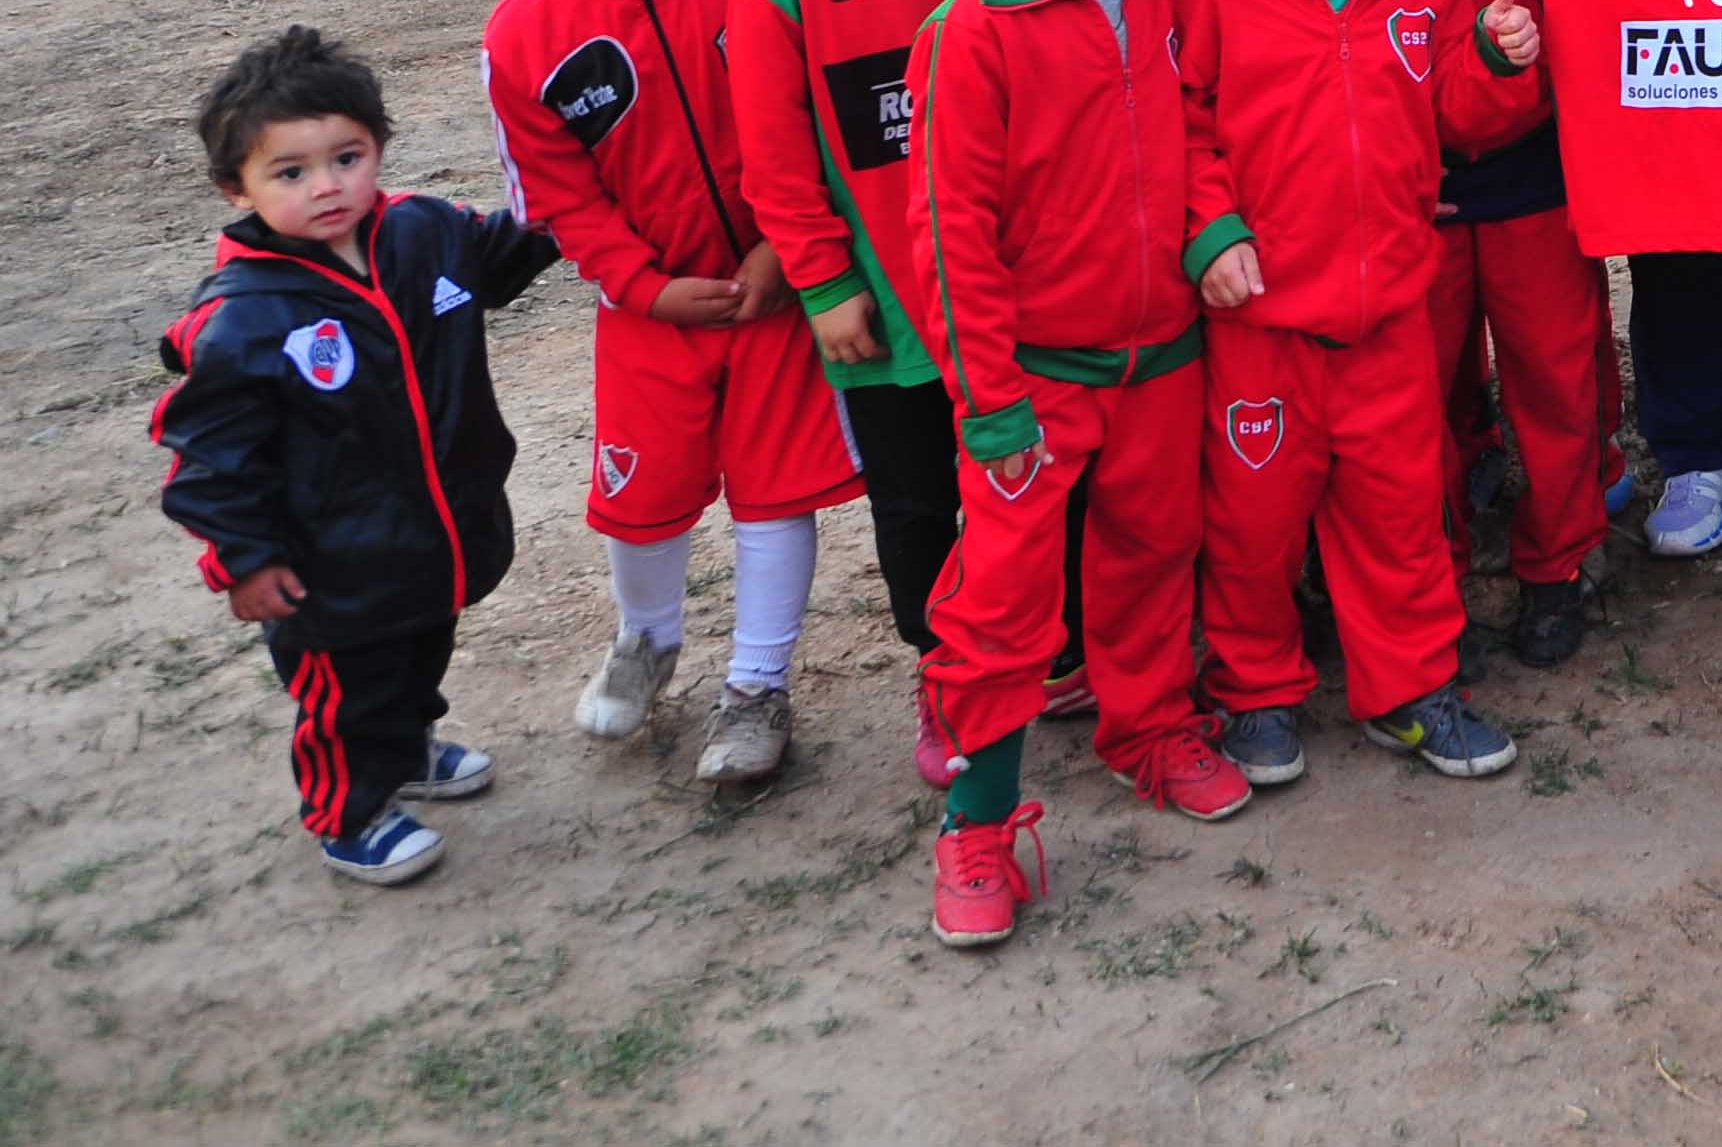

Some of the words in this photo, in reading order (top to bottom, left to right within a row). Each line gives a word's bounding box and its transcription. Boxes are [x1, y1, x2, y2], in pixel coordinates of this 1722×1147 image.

[1401, 31, 1428, 45] CSP
[1627, 84, 1718, 99] soluciones
[1239, 418, 1273, 434] CSP
